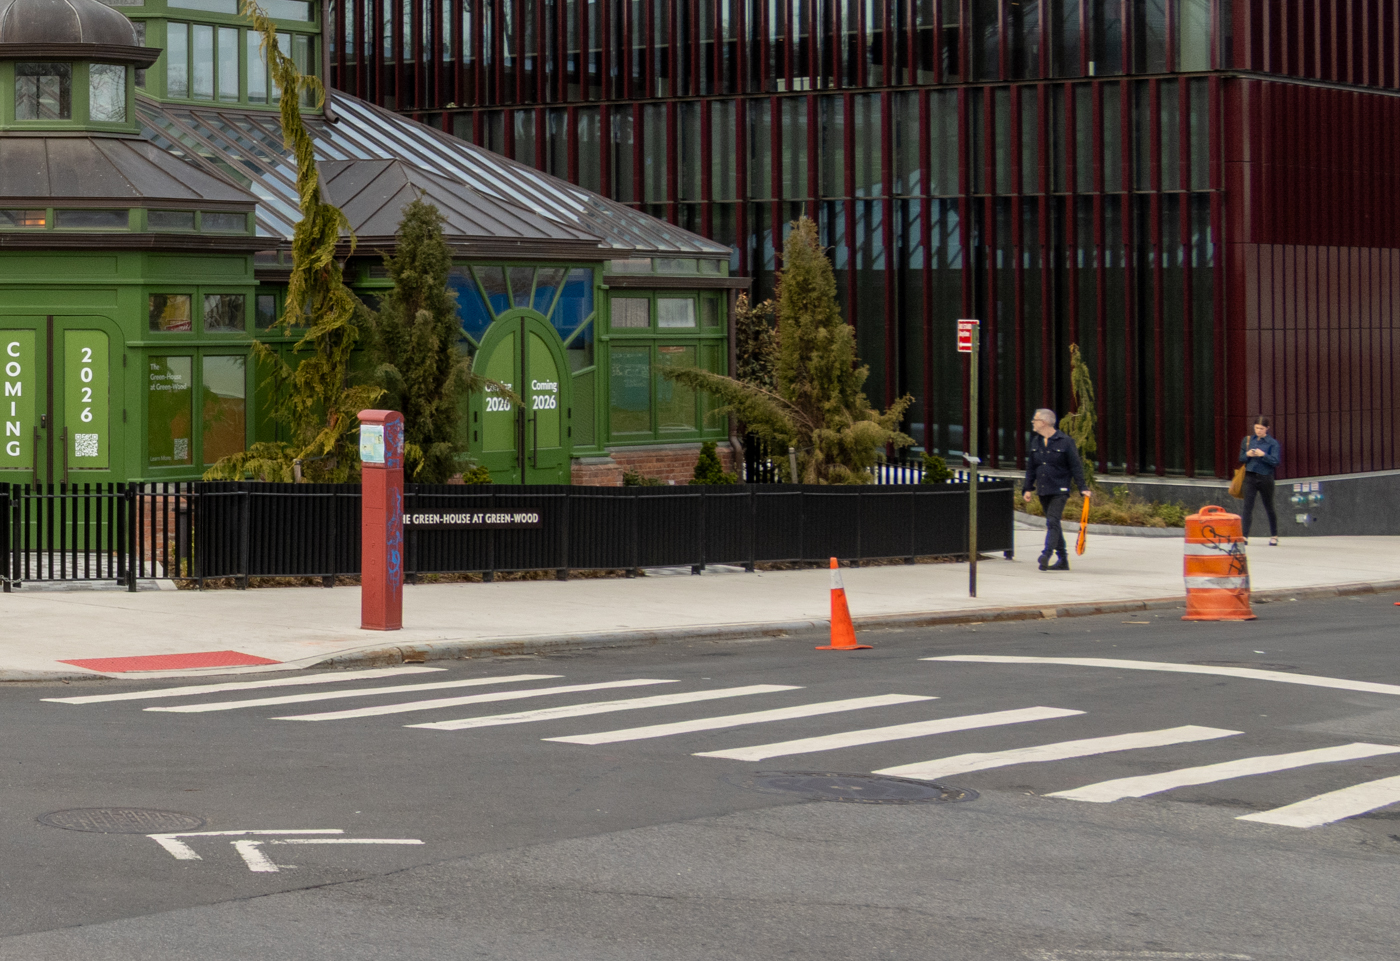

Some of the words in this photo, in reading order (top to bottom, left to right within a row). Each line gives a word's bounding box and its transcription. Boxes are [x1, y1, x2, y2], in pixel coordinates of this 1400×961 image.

[150, 372, 182, 380] Green-House
[80, 347, 93, 423] 2026
[531, 379, 558, 393] Coming
[4, 341, 22, 456] COMING
[532, 395, 557, 409] 2026
[412, 514, 471, 524] GREEN-HOUSE
[472, 514, 484, 523] AT
[485, 513, 539, 524] GREEN-WOOD
